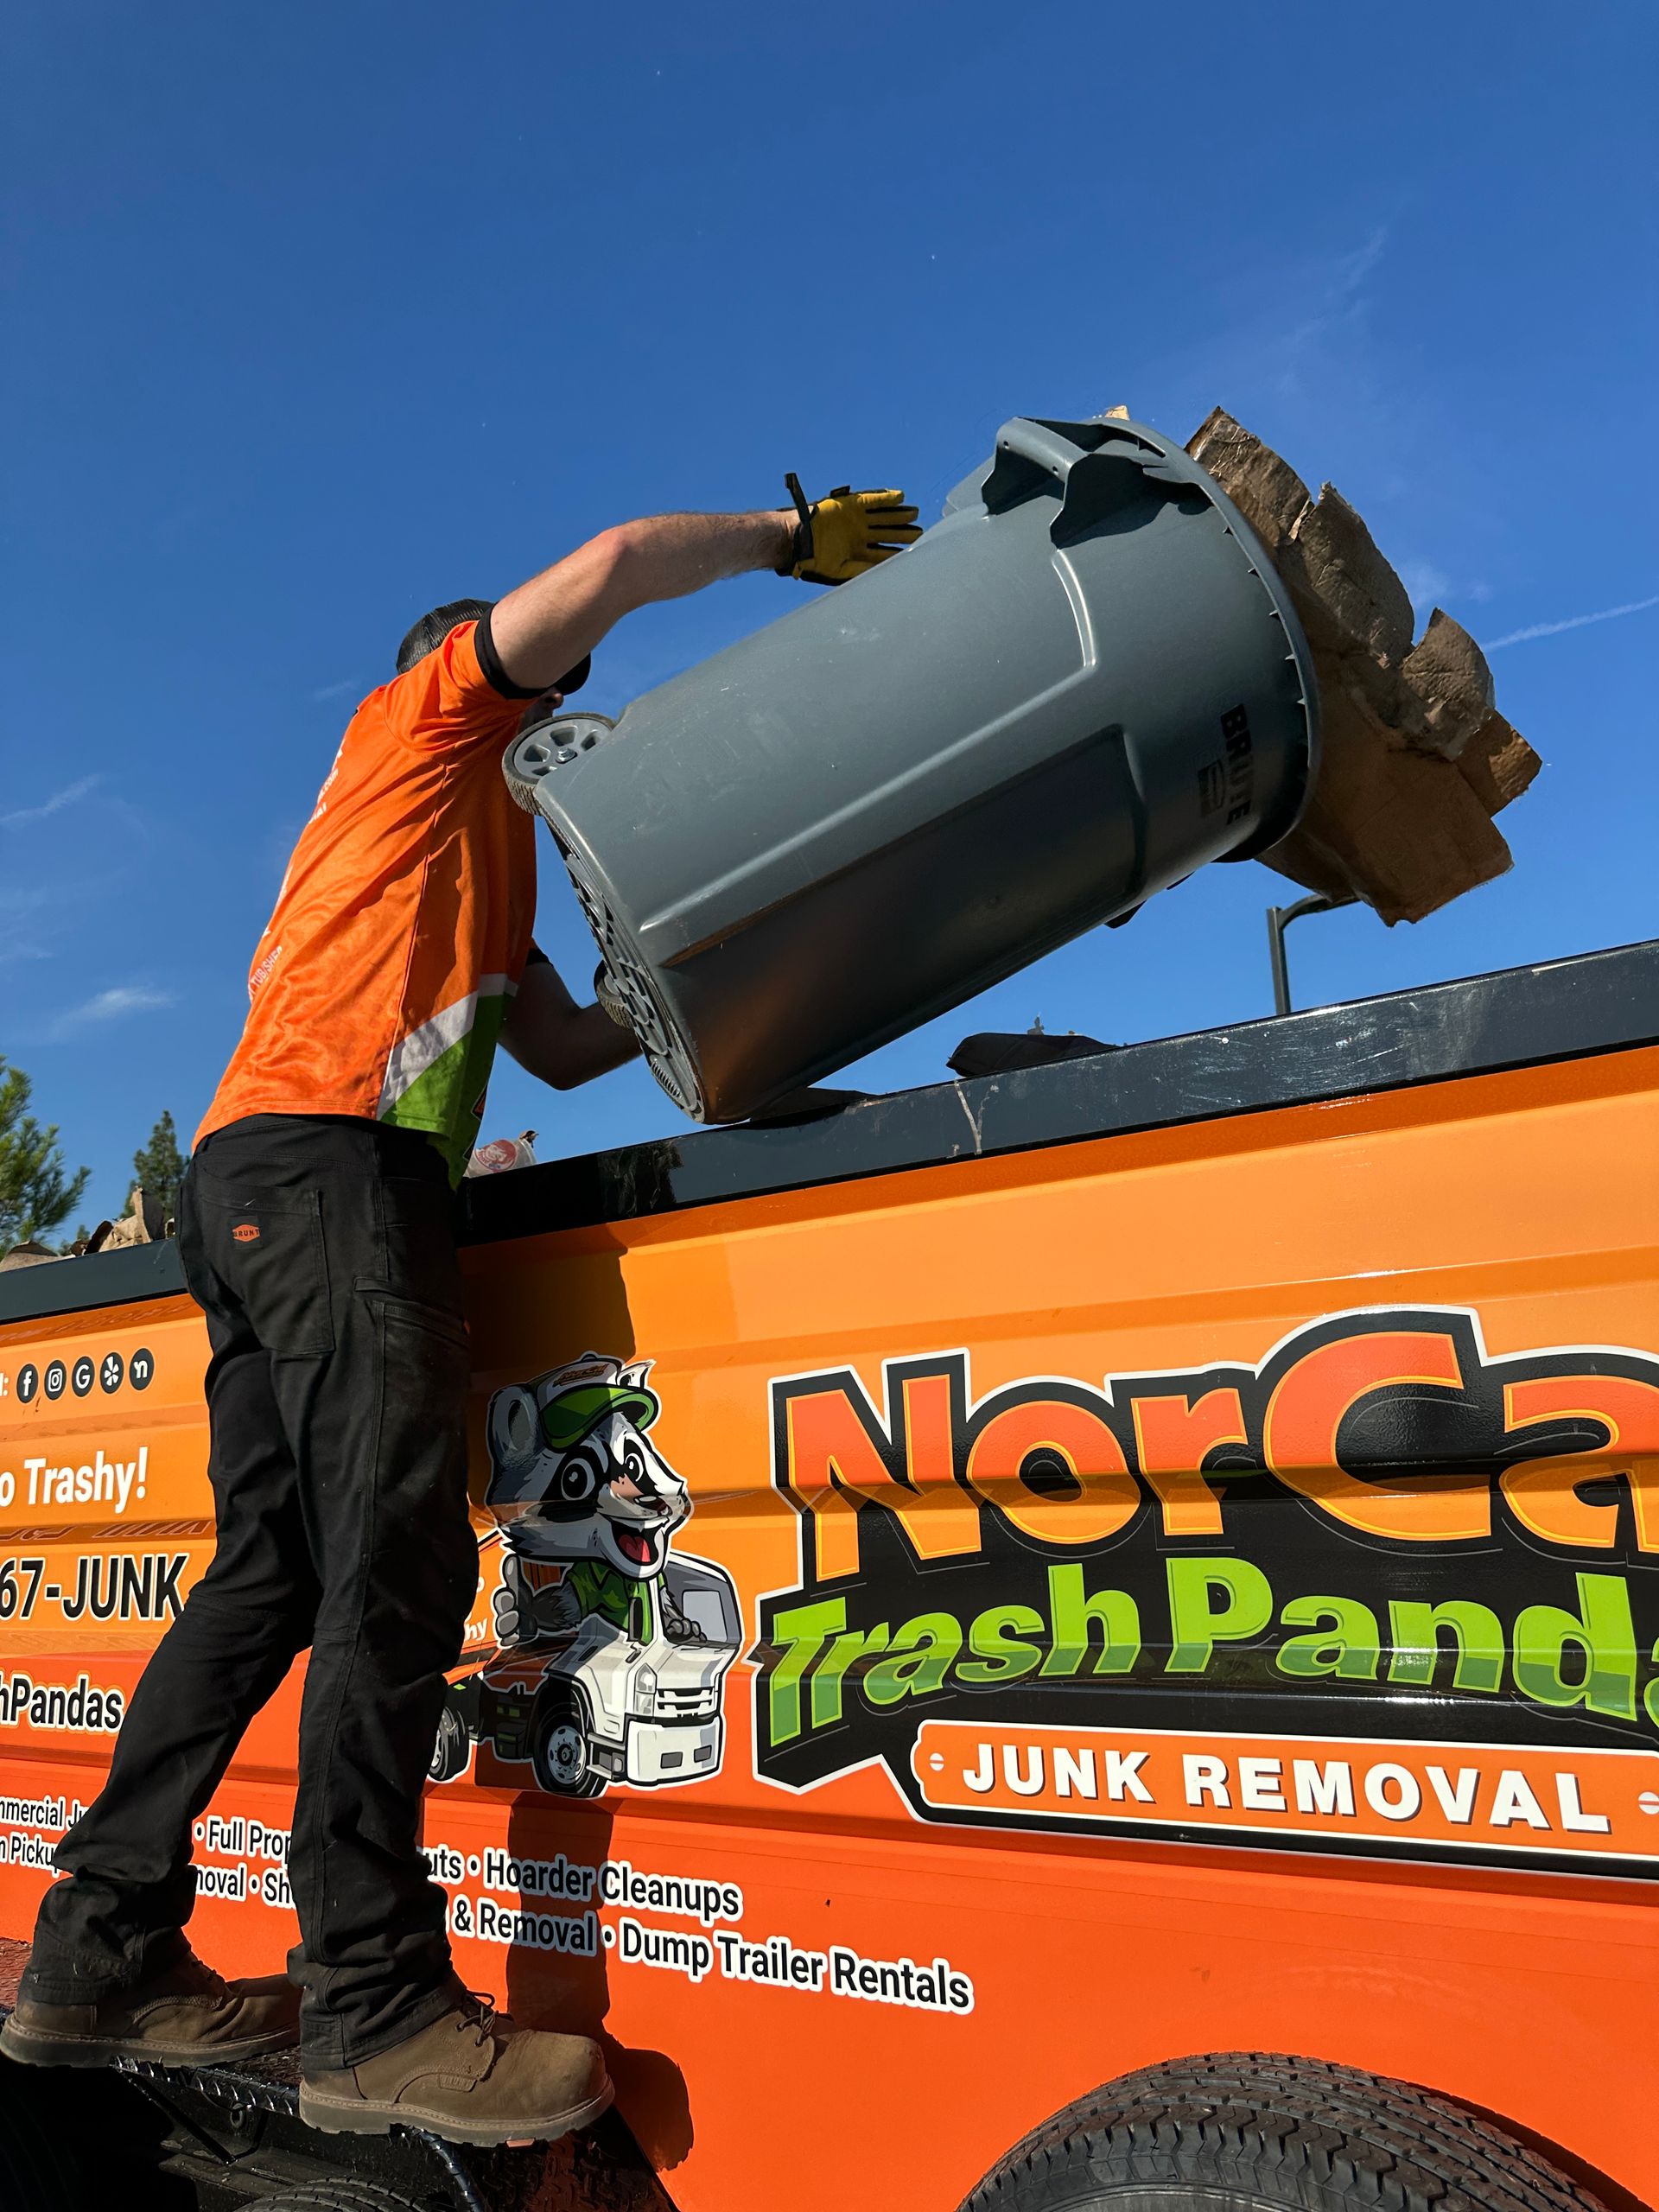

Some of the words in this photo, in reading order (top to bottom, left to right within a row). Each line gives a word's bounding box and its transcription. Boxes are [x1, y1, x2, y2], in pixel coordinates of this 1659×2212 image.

[24, 1446, 148, 1514] Trashy!
[770, 1565, 1141, 1744] Trash
[1165, 1557, 1659, 1730] Pand
[963, 1743, 1154, 1804] JUNK
[1184, 1754, 1612, 1833] REMOVAL
[11, 1835, 58, 1874] Picku
[454, 1899, 473, 1933] &
[480, 1903, 594, 1952] Removal
[623, 1923, 710, 1978] Dump
[718, 1937, 824, 1985] Trailer
[836, 1953, 971, 2009] Rentals
[209, 1820, 243, 1851] Full
[486, 1852, 593, 1897] Hoarder
[602, 1866, 741, 1923] Cleanups
